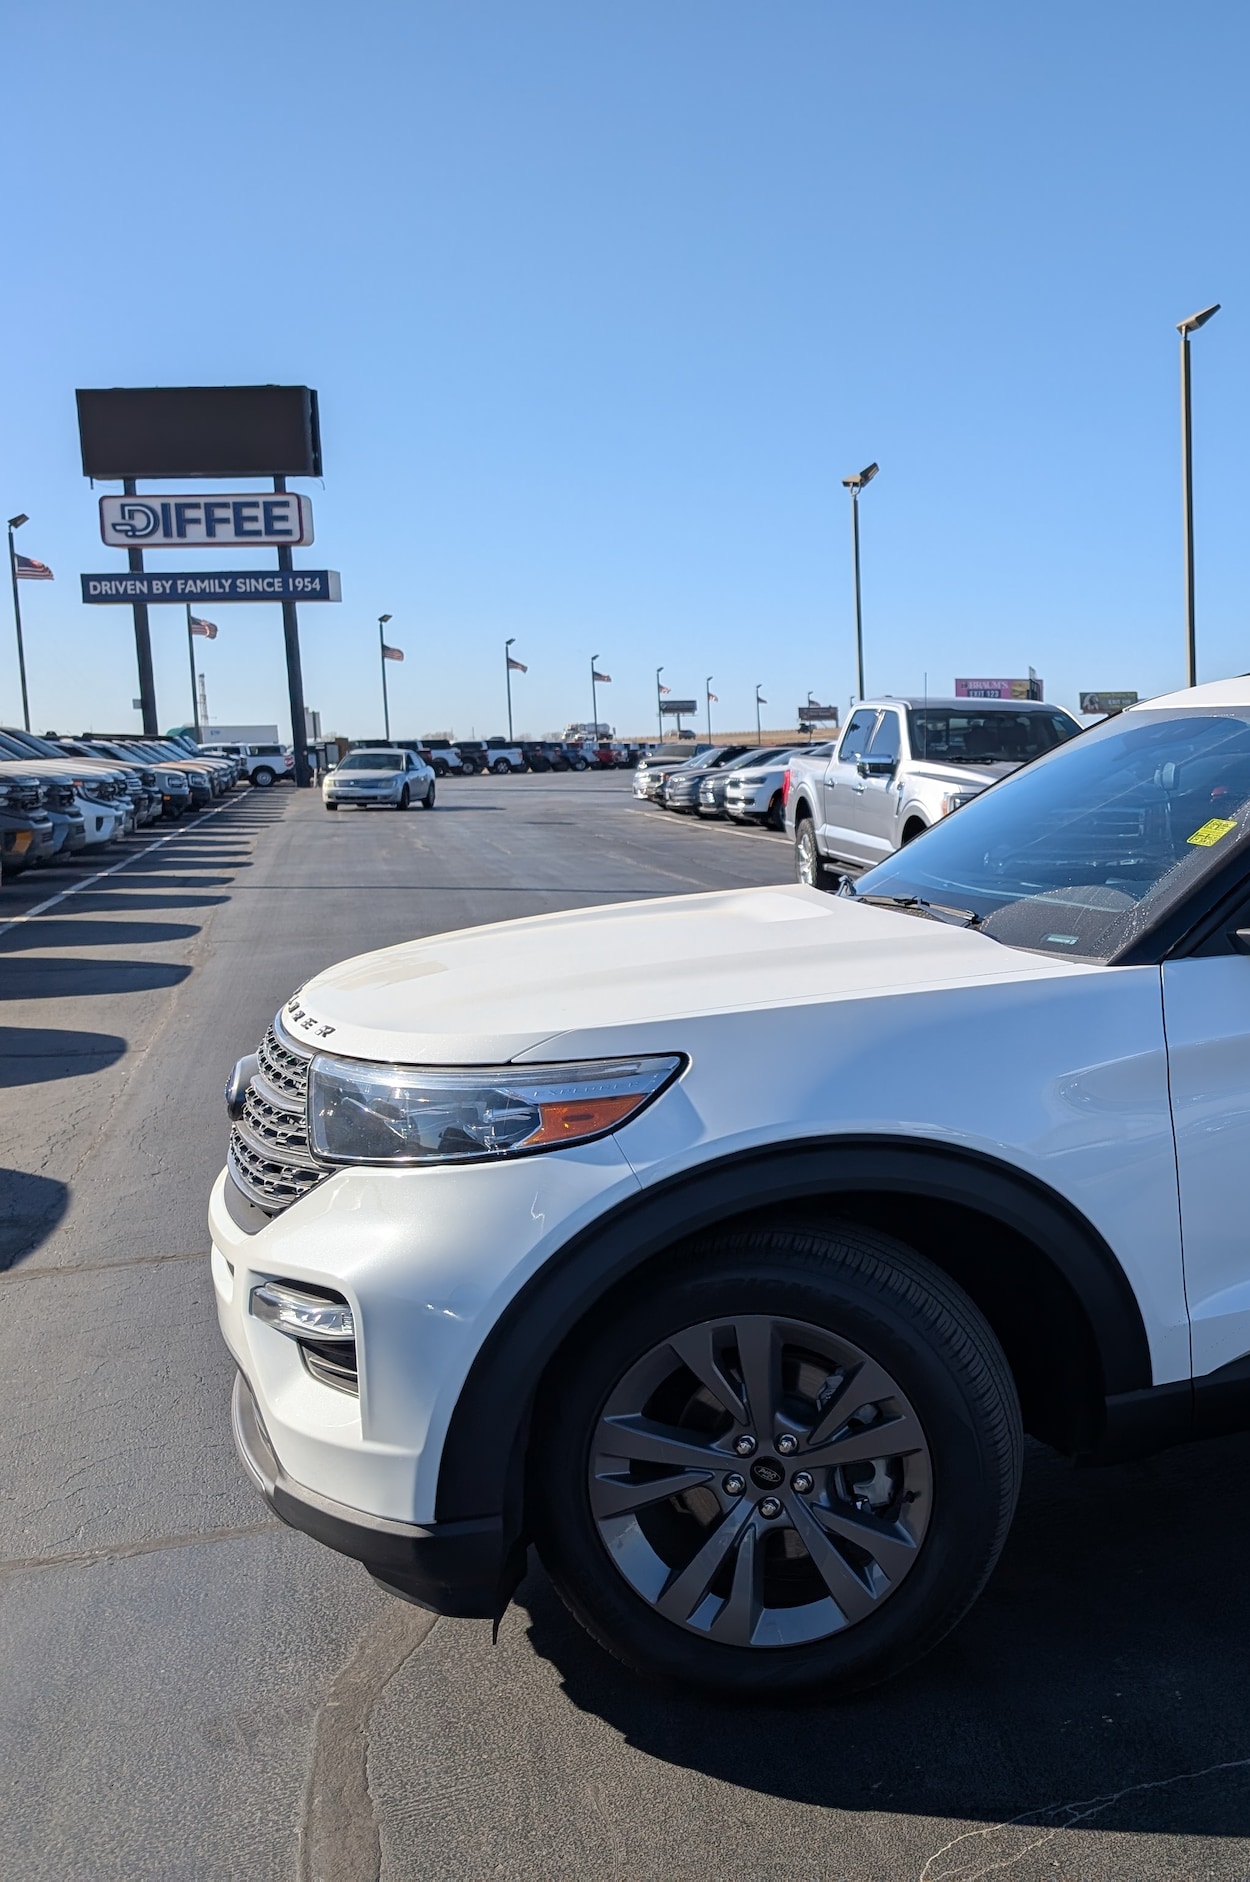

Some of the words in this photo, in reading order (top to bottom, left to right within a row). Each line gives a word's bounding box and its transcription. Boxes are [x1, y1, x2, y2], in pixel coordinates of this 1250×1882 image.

[111, 500, 293, 539] DIFFEE
[88, 580, 149, 595] DRIVEN
[151, 579, 173, 594] BY
[177, 578, 232, 594] FAMILY
[236, 577, 283, 592] SINCE
[288, 577, 321, 591] 1954
[986, 690, 1000, 698] 123
